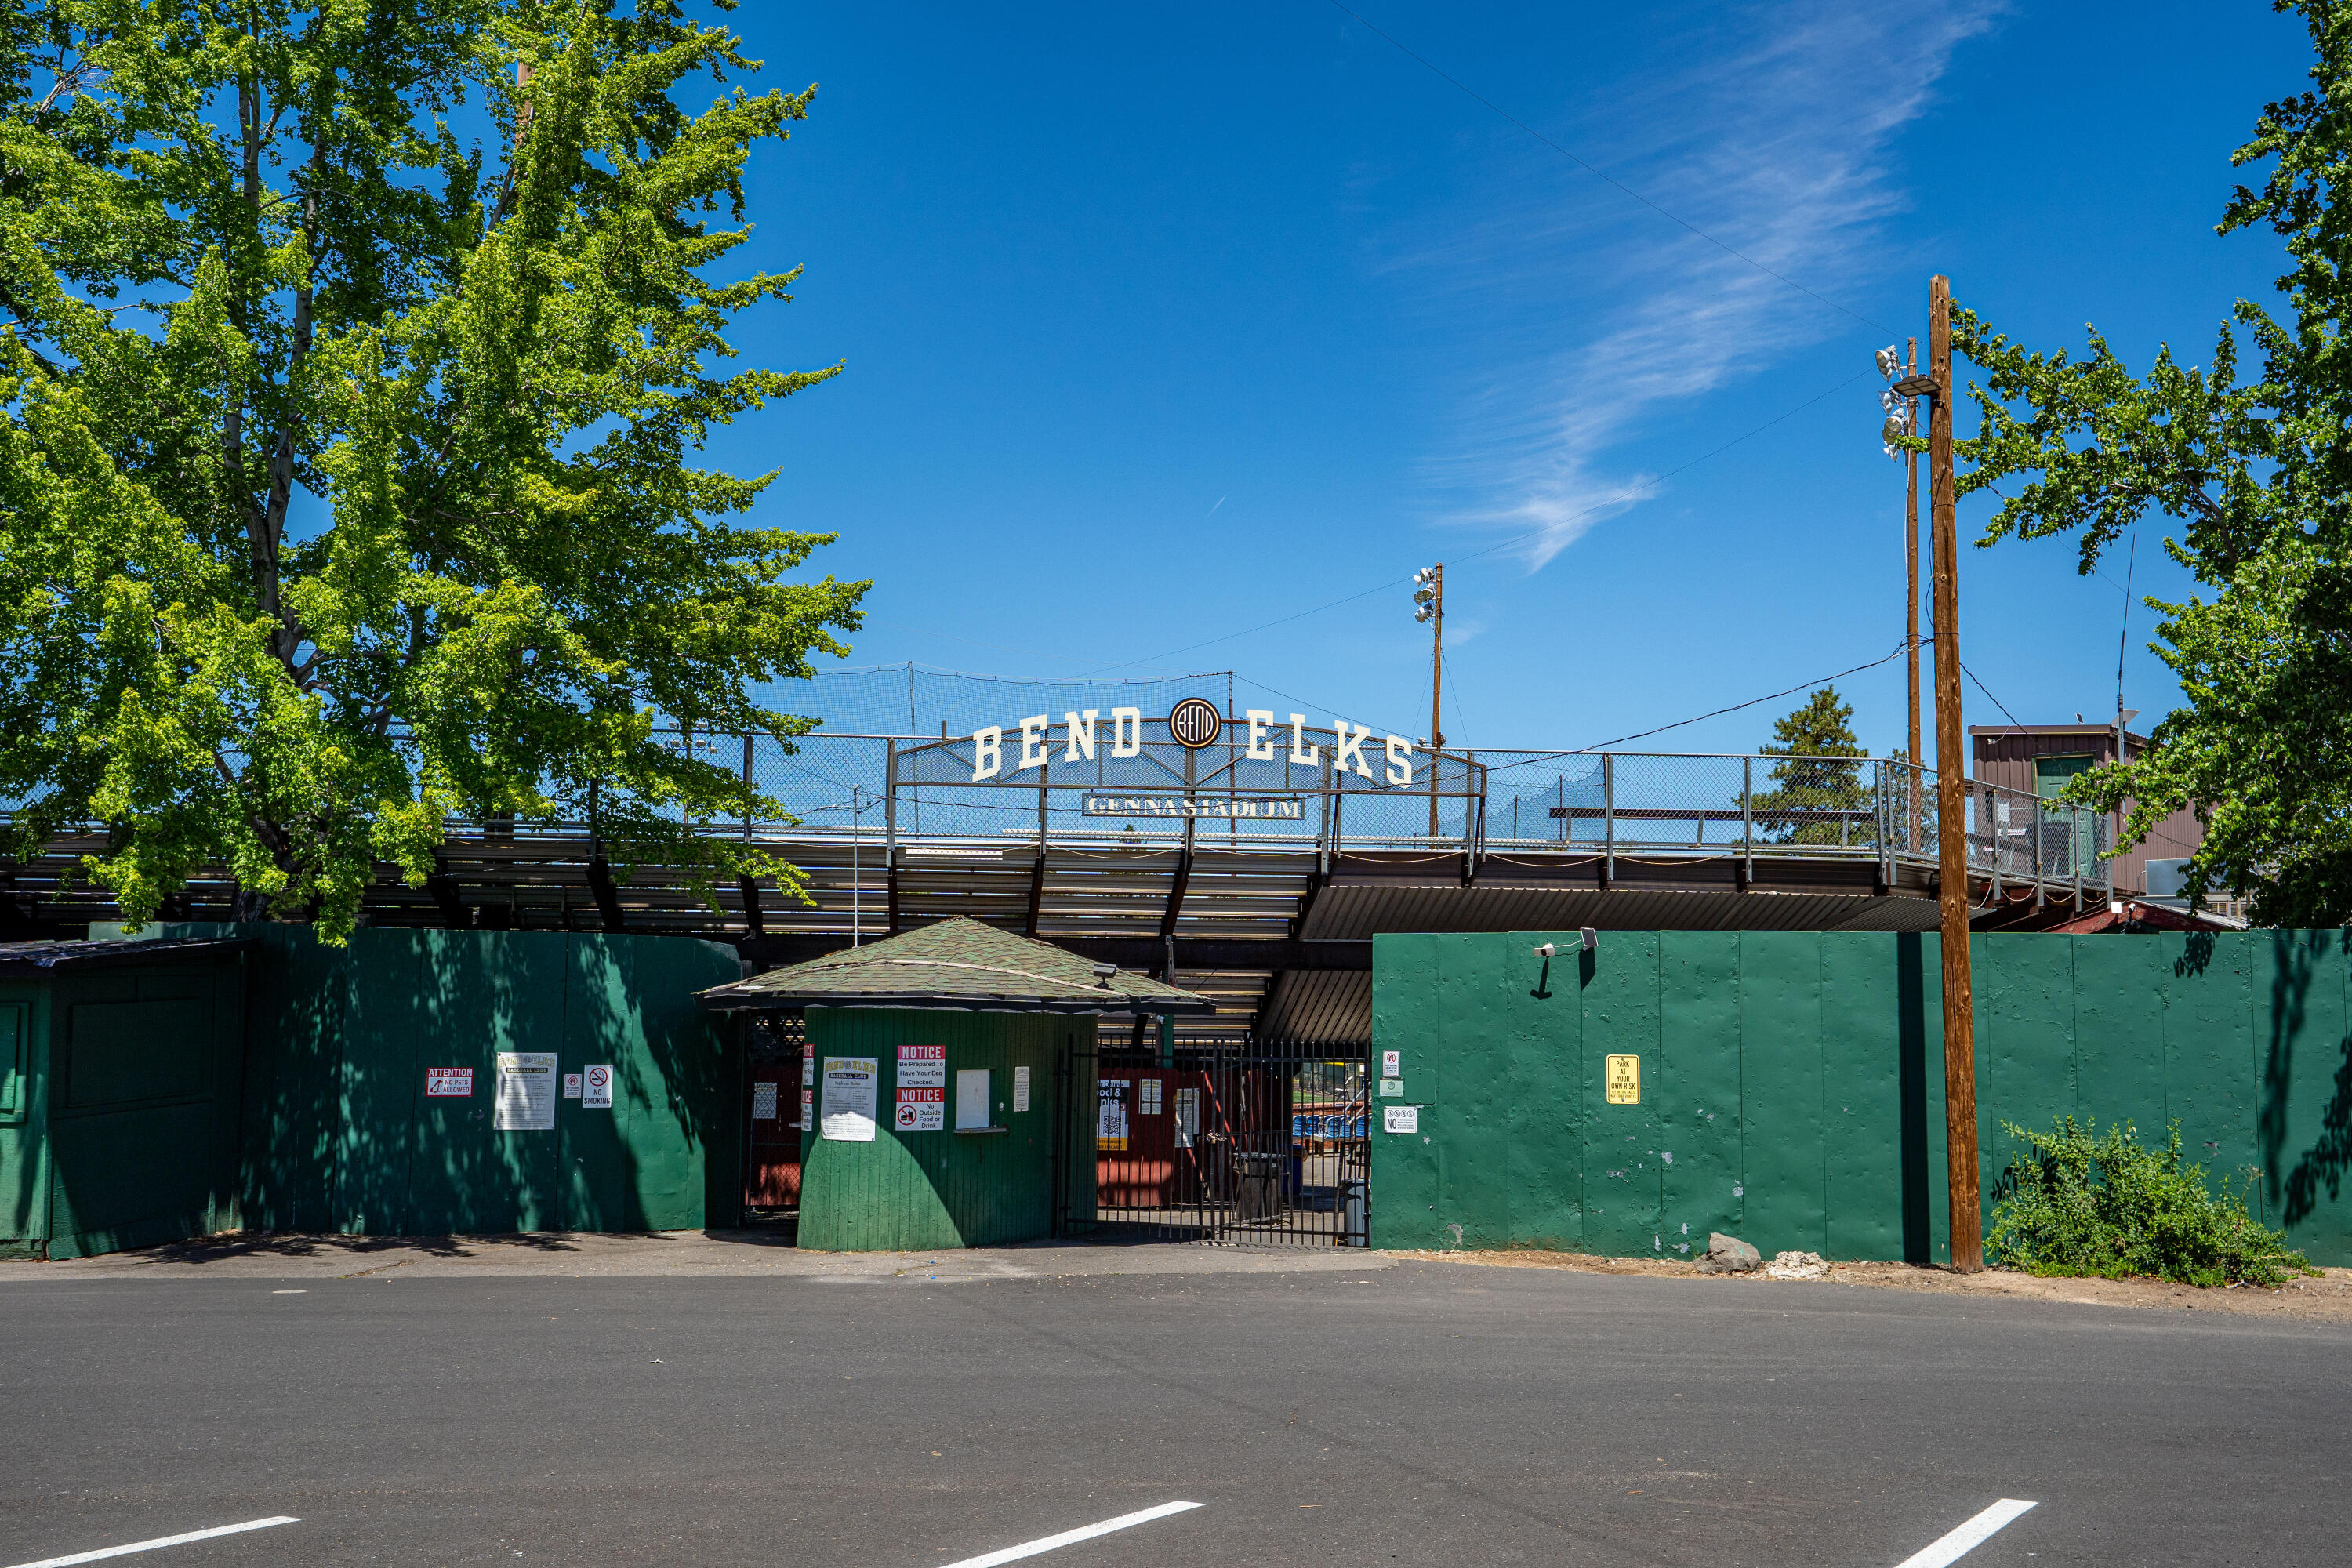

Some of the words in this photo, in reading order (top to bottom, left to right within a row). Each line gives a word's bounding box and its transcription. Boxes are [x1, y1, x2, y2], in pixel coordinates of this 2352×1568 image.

[1177, 705, 1214, 742] BEND
[971, 706, 1141, 782] BEND
[1246, 709, 1412, 788] ELKS
[1088, 797, 1176, 815] GENNA
[1183, 799, 1299, 818] STADIUM
[902, 1047, 941, 1058] NOTICE
[429, 1068, 473, 1076] ATTENTION
[852, 1060, 876, 1074] ELKS
[901, 1089, 940, 1102] NOTICE
[1388, 1118, 1397, 1130] NO
